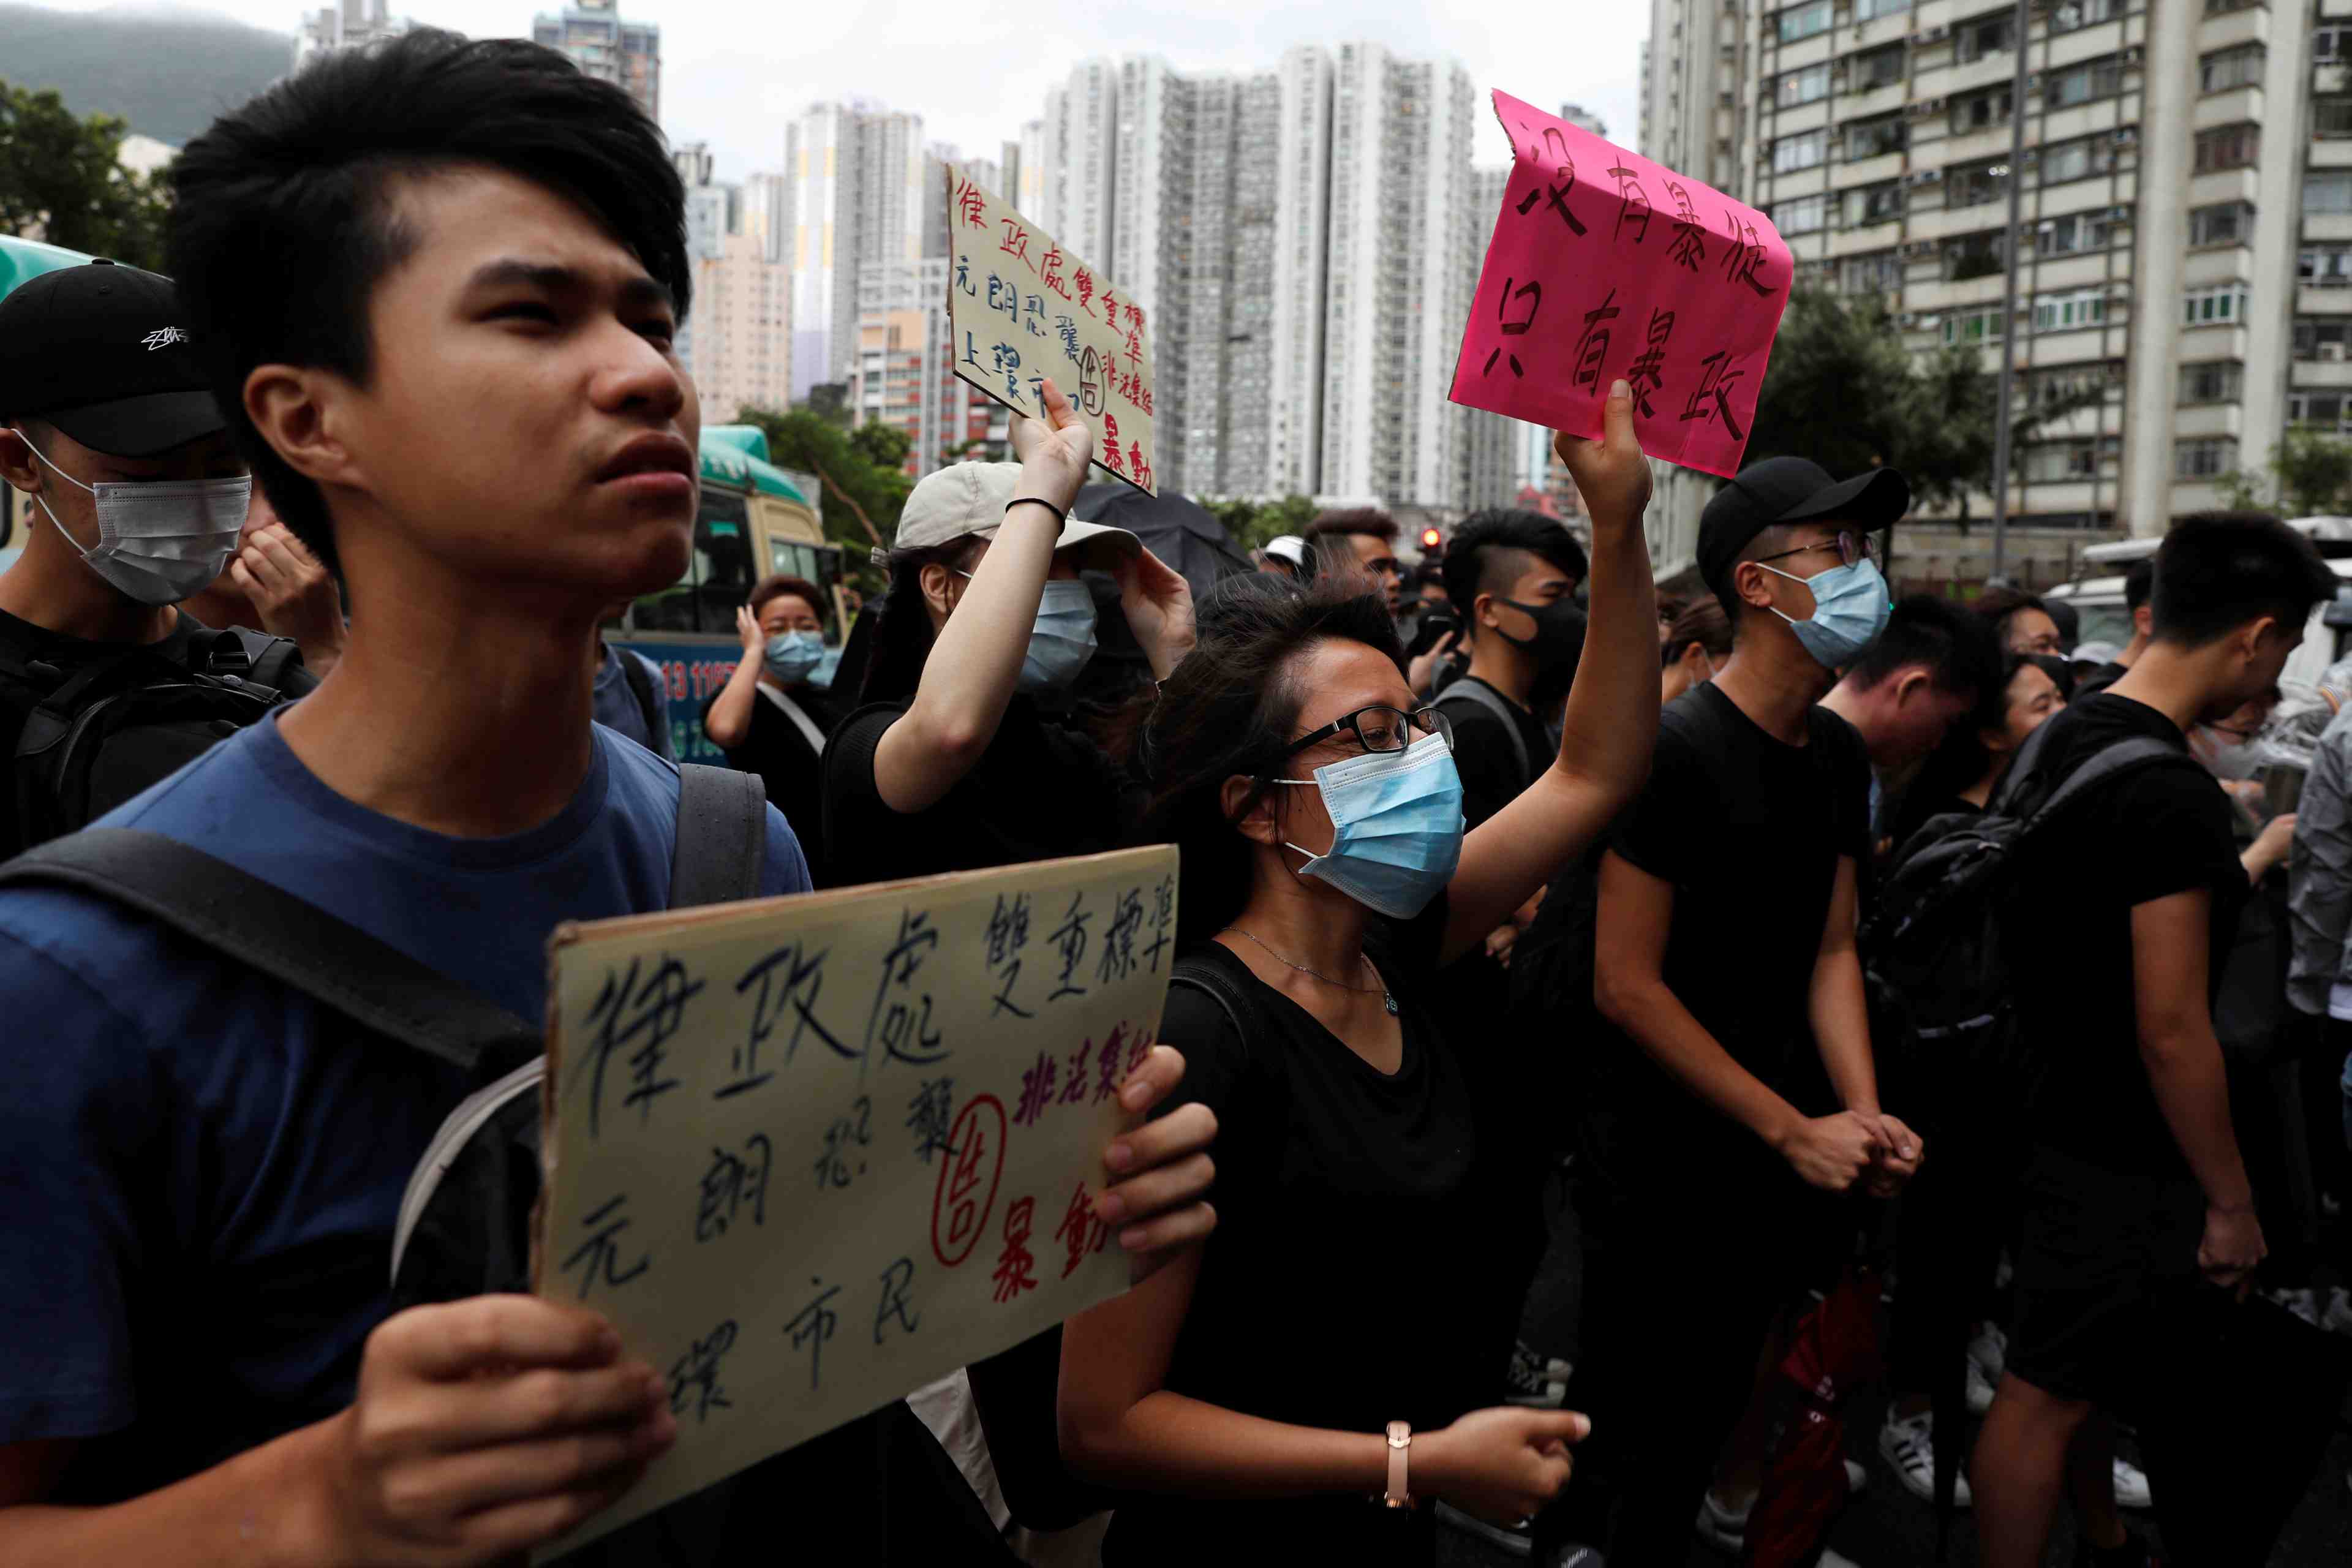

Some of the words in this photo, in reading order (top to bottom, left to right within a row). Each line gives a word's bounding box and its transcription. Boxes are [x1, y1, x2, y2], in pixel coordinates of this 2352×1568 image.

[960, 331, 1080, 418] 上環市
[1483, 277, 1744, 441] 只有暴政
[1102, 412, 1152, 491] 暴動
[666, 1256, 919, 1422] 環市民
